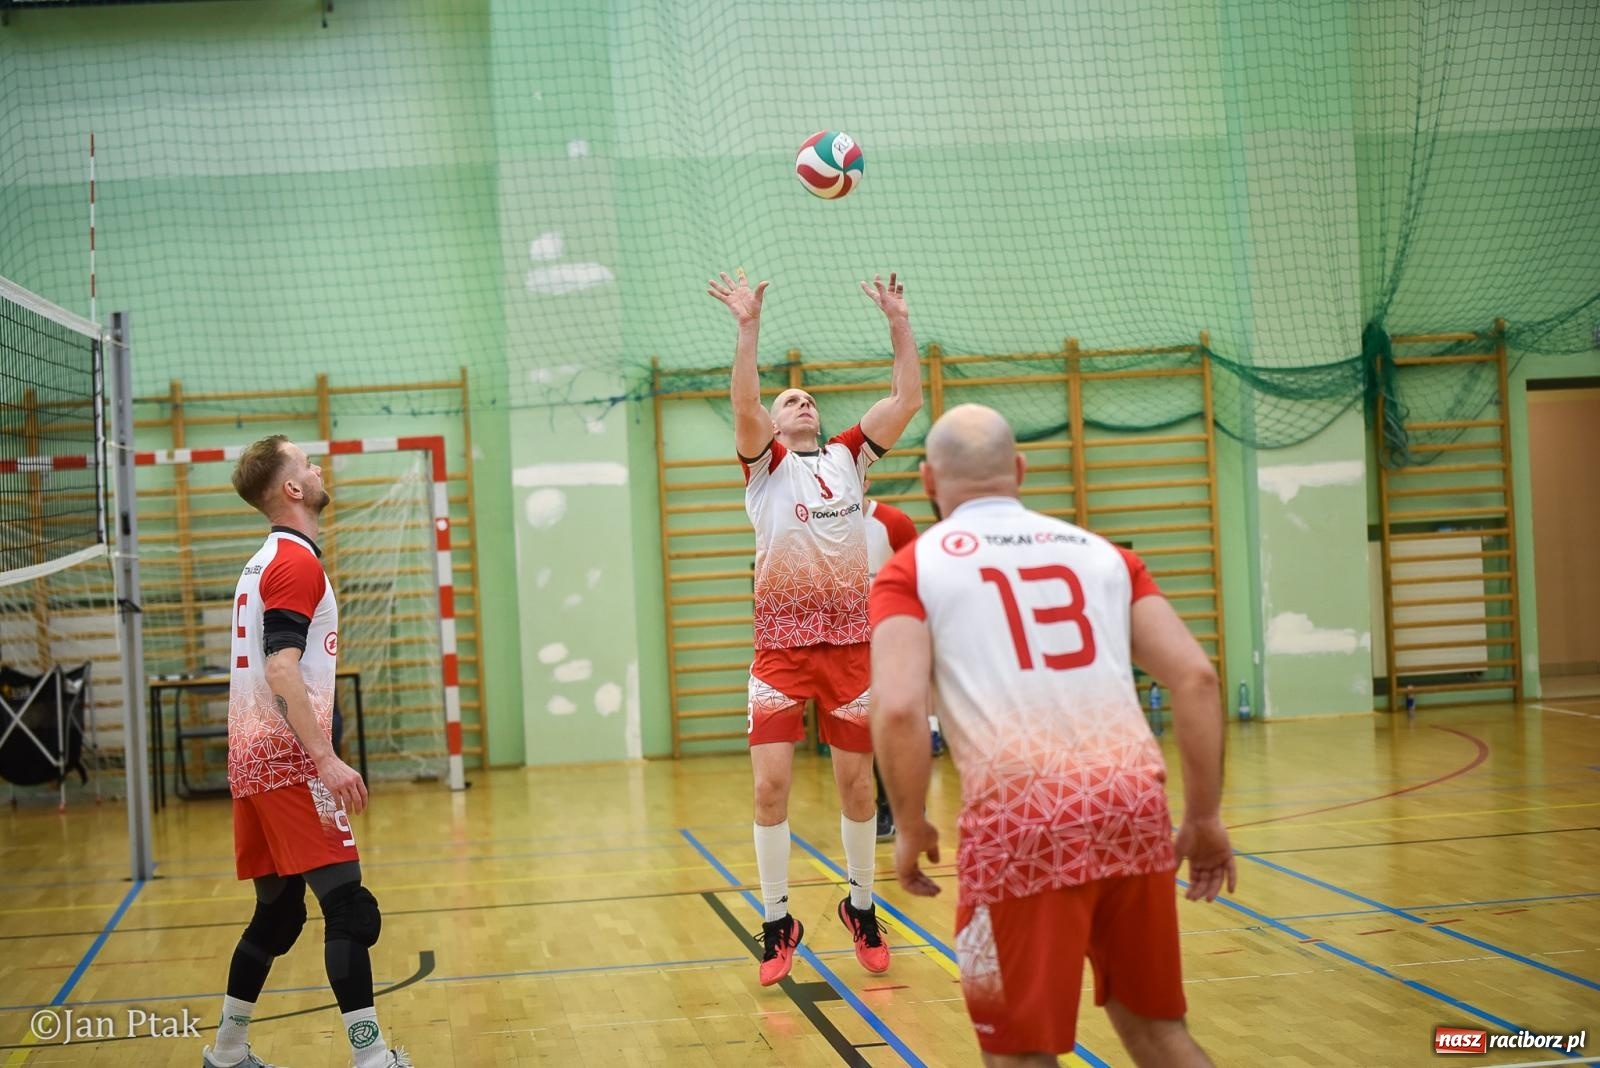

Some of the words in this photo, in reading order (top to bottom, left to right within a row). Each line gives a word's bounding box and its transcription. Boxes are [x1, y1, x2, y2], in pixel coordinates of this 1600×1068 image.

[814, 474, 833, 499] 3
[811, 511, 838, 519] TOKAI
[979, 564, 1096, 671] 13
